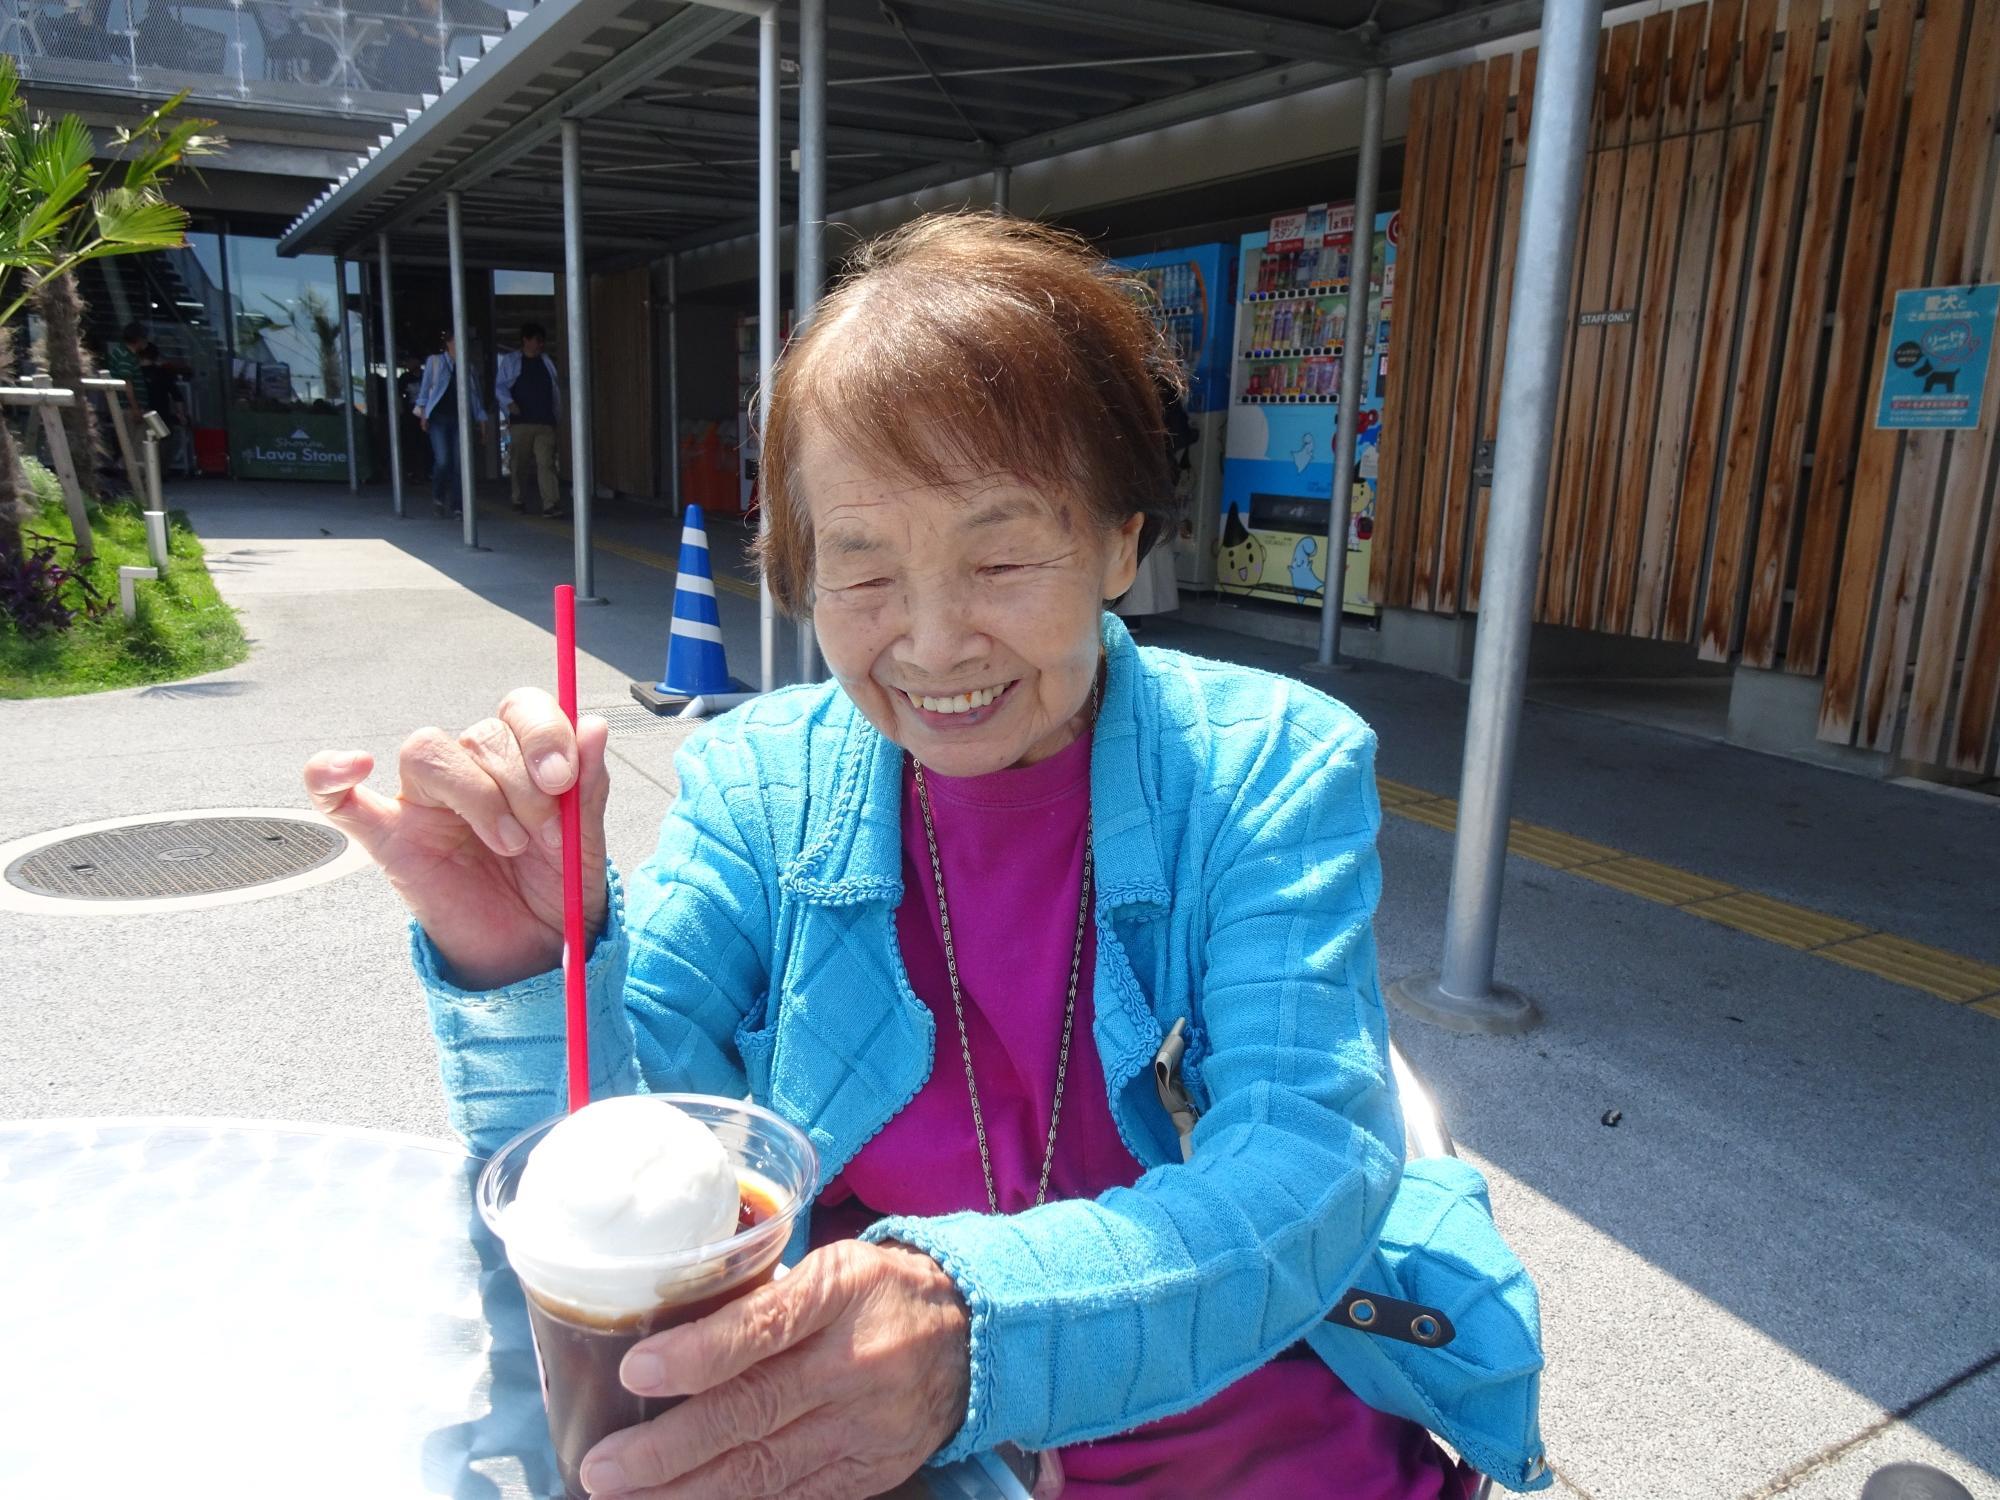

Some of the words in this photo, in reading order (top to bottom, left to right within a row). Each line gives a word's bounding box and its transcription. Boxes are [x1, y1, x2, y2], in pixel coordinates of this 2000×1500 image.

[1581, 314, 1606, 324] STAFF
[1608, 312, 1632, 322] ONLY
[255, 446, 297, 461] Lava
[302, 447, 347, 462] Stone
